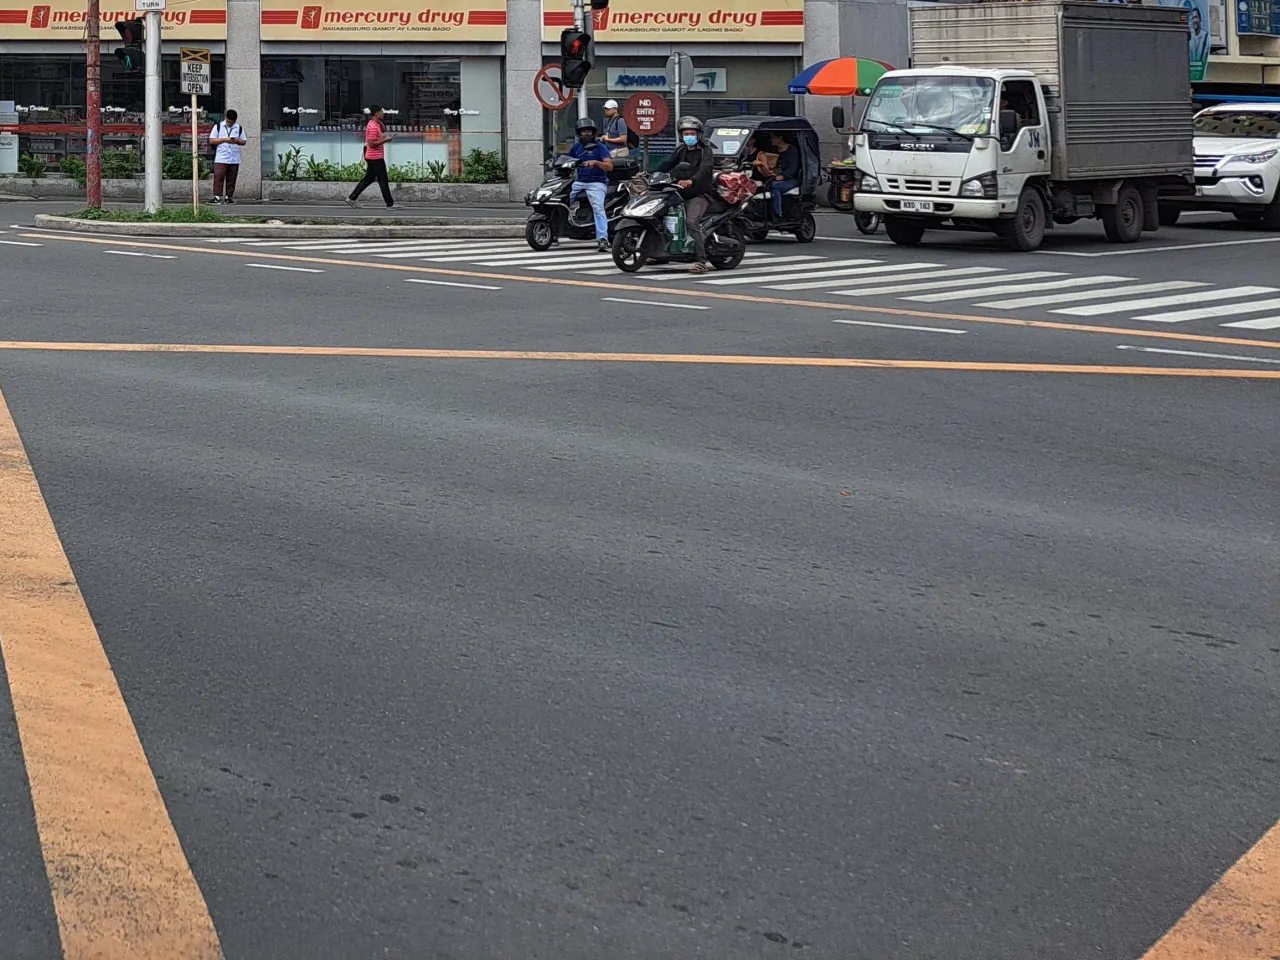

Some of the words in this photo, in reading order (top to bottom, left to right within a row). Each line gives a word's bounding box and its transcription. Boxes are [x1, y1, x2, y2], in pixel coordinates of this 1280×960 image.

[324, 11, 411, 26] mercury
[418, 9, 464, 26] drug
[612, 11, 702, 26] mercury
[708, 9, 757, 27] drug
[187, 63, 203, 73] KEEP
[187, 82, 203, 92] OPEN
[639, 99, 652, 107] NO
[636, 108, 656, 116] ENTRY
